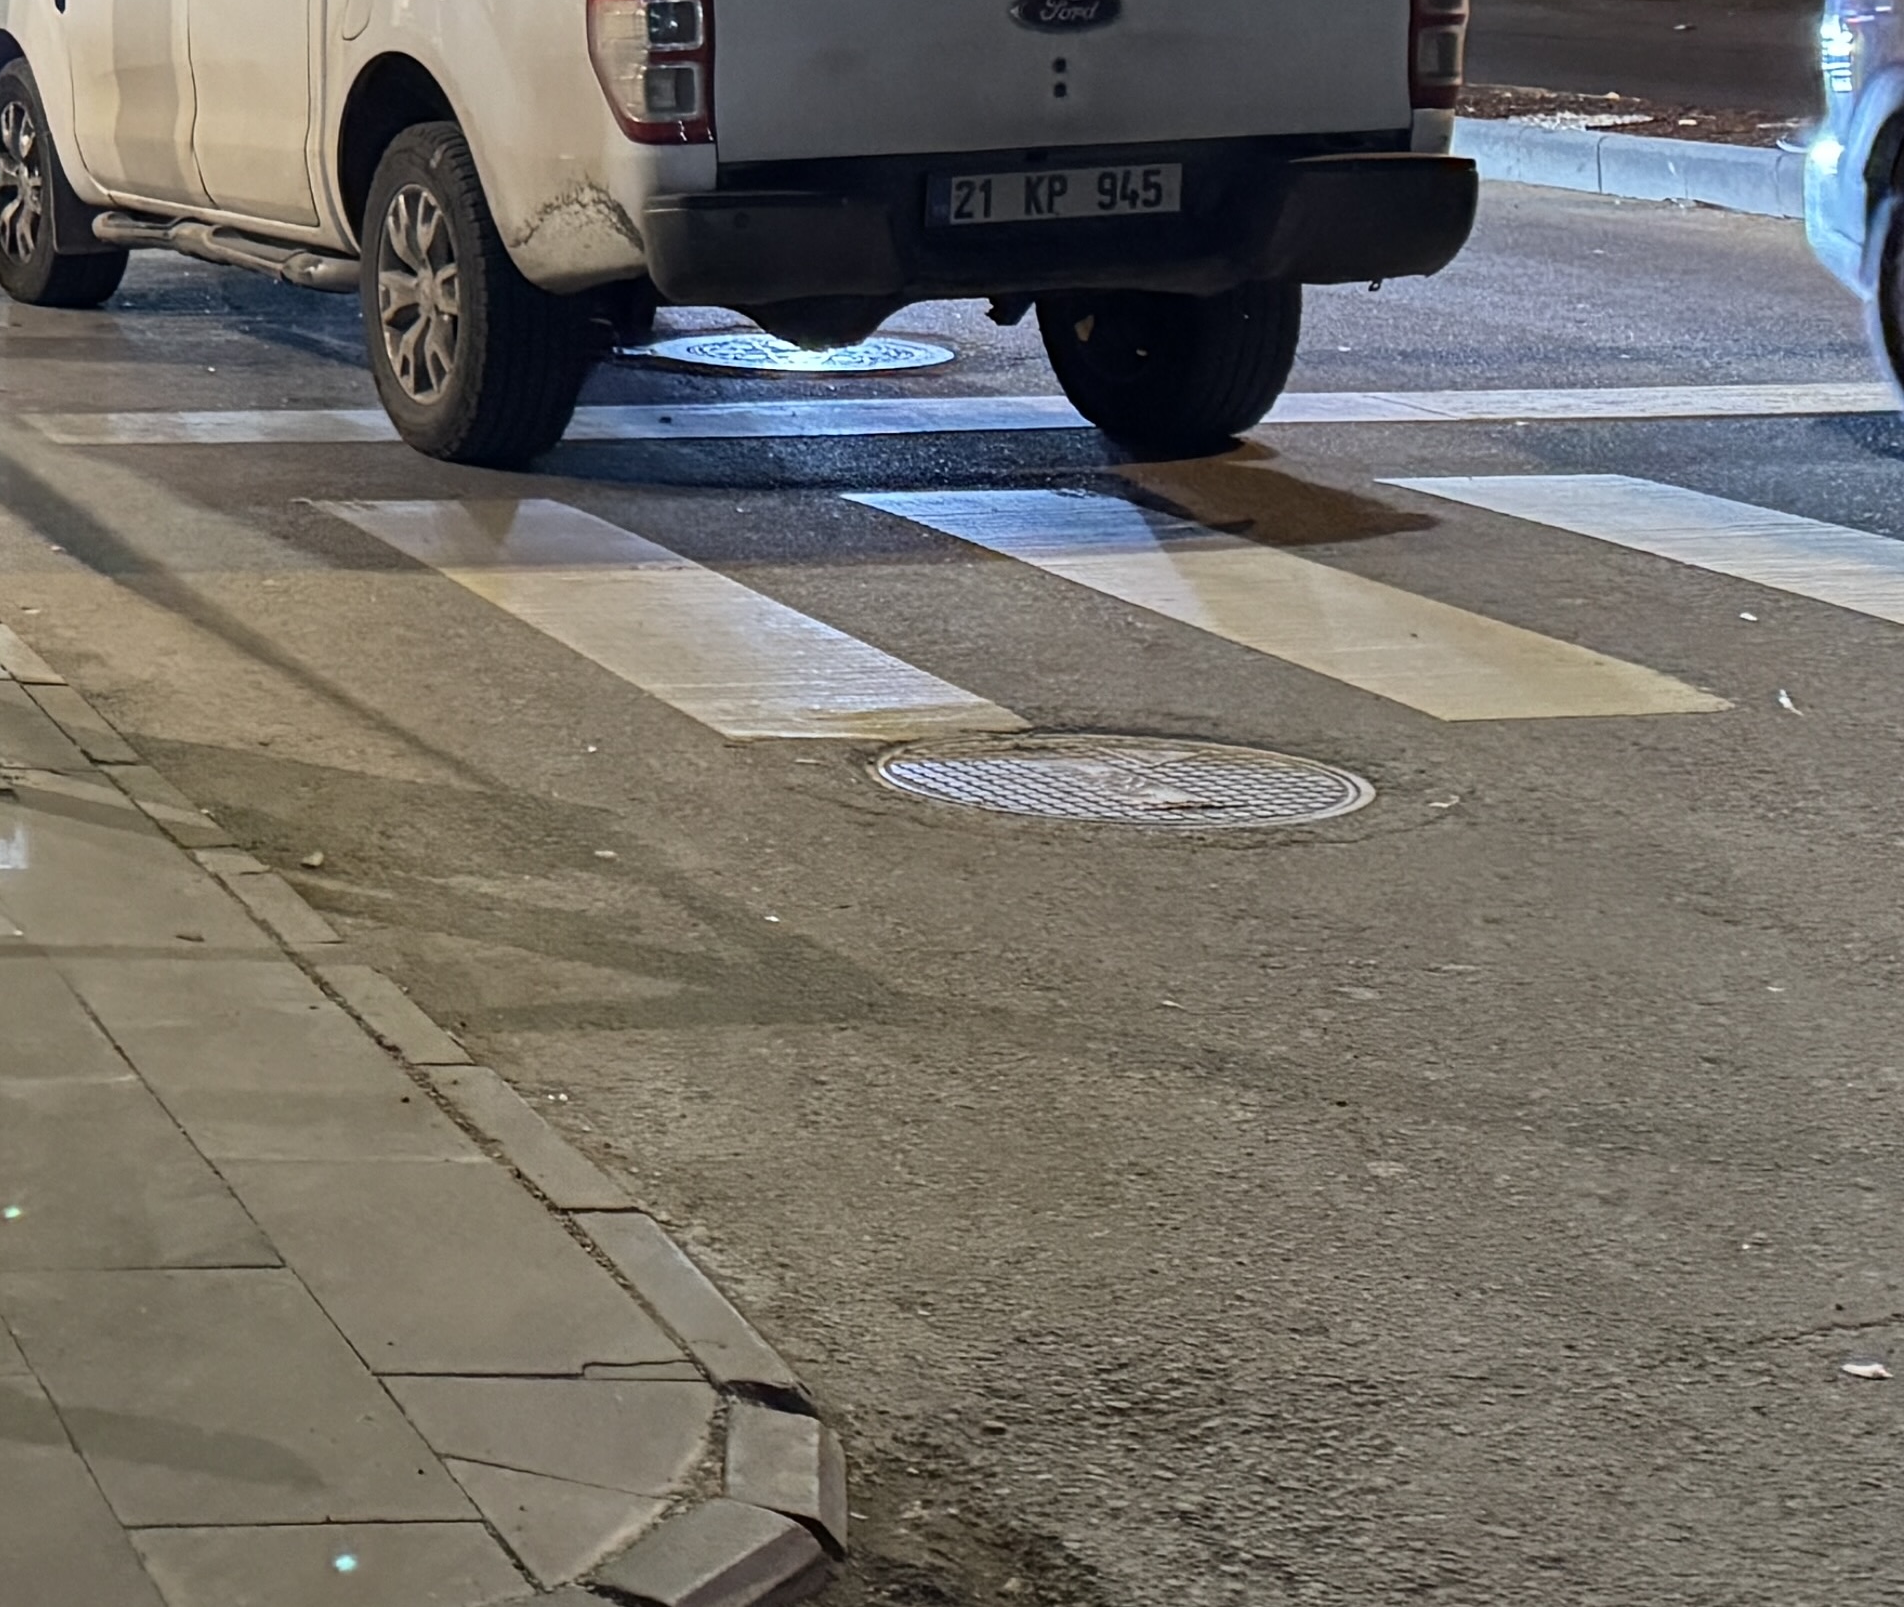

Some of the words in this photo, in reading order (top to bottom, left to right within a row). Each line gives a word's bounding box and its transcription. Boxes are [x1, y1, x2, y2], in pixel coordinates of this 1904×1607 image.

[953, 179, 992, 220] 21
[1024, 174, 1069, 216] KP
[1097, 169, 1163, 210] 945
